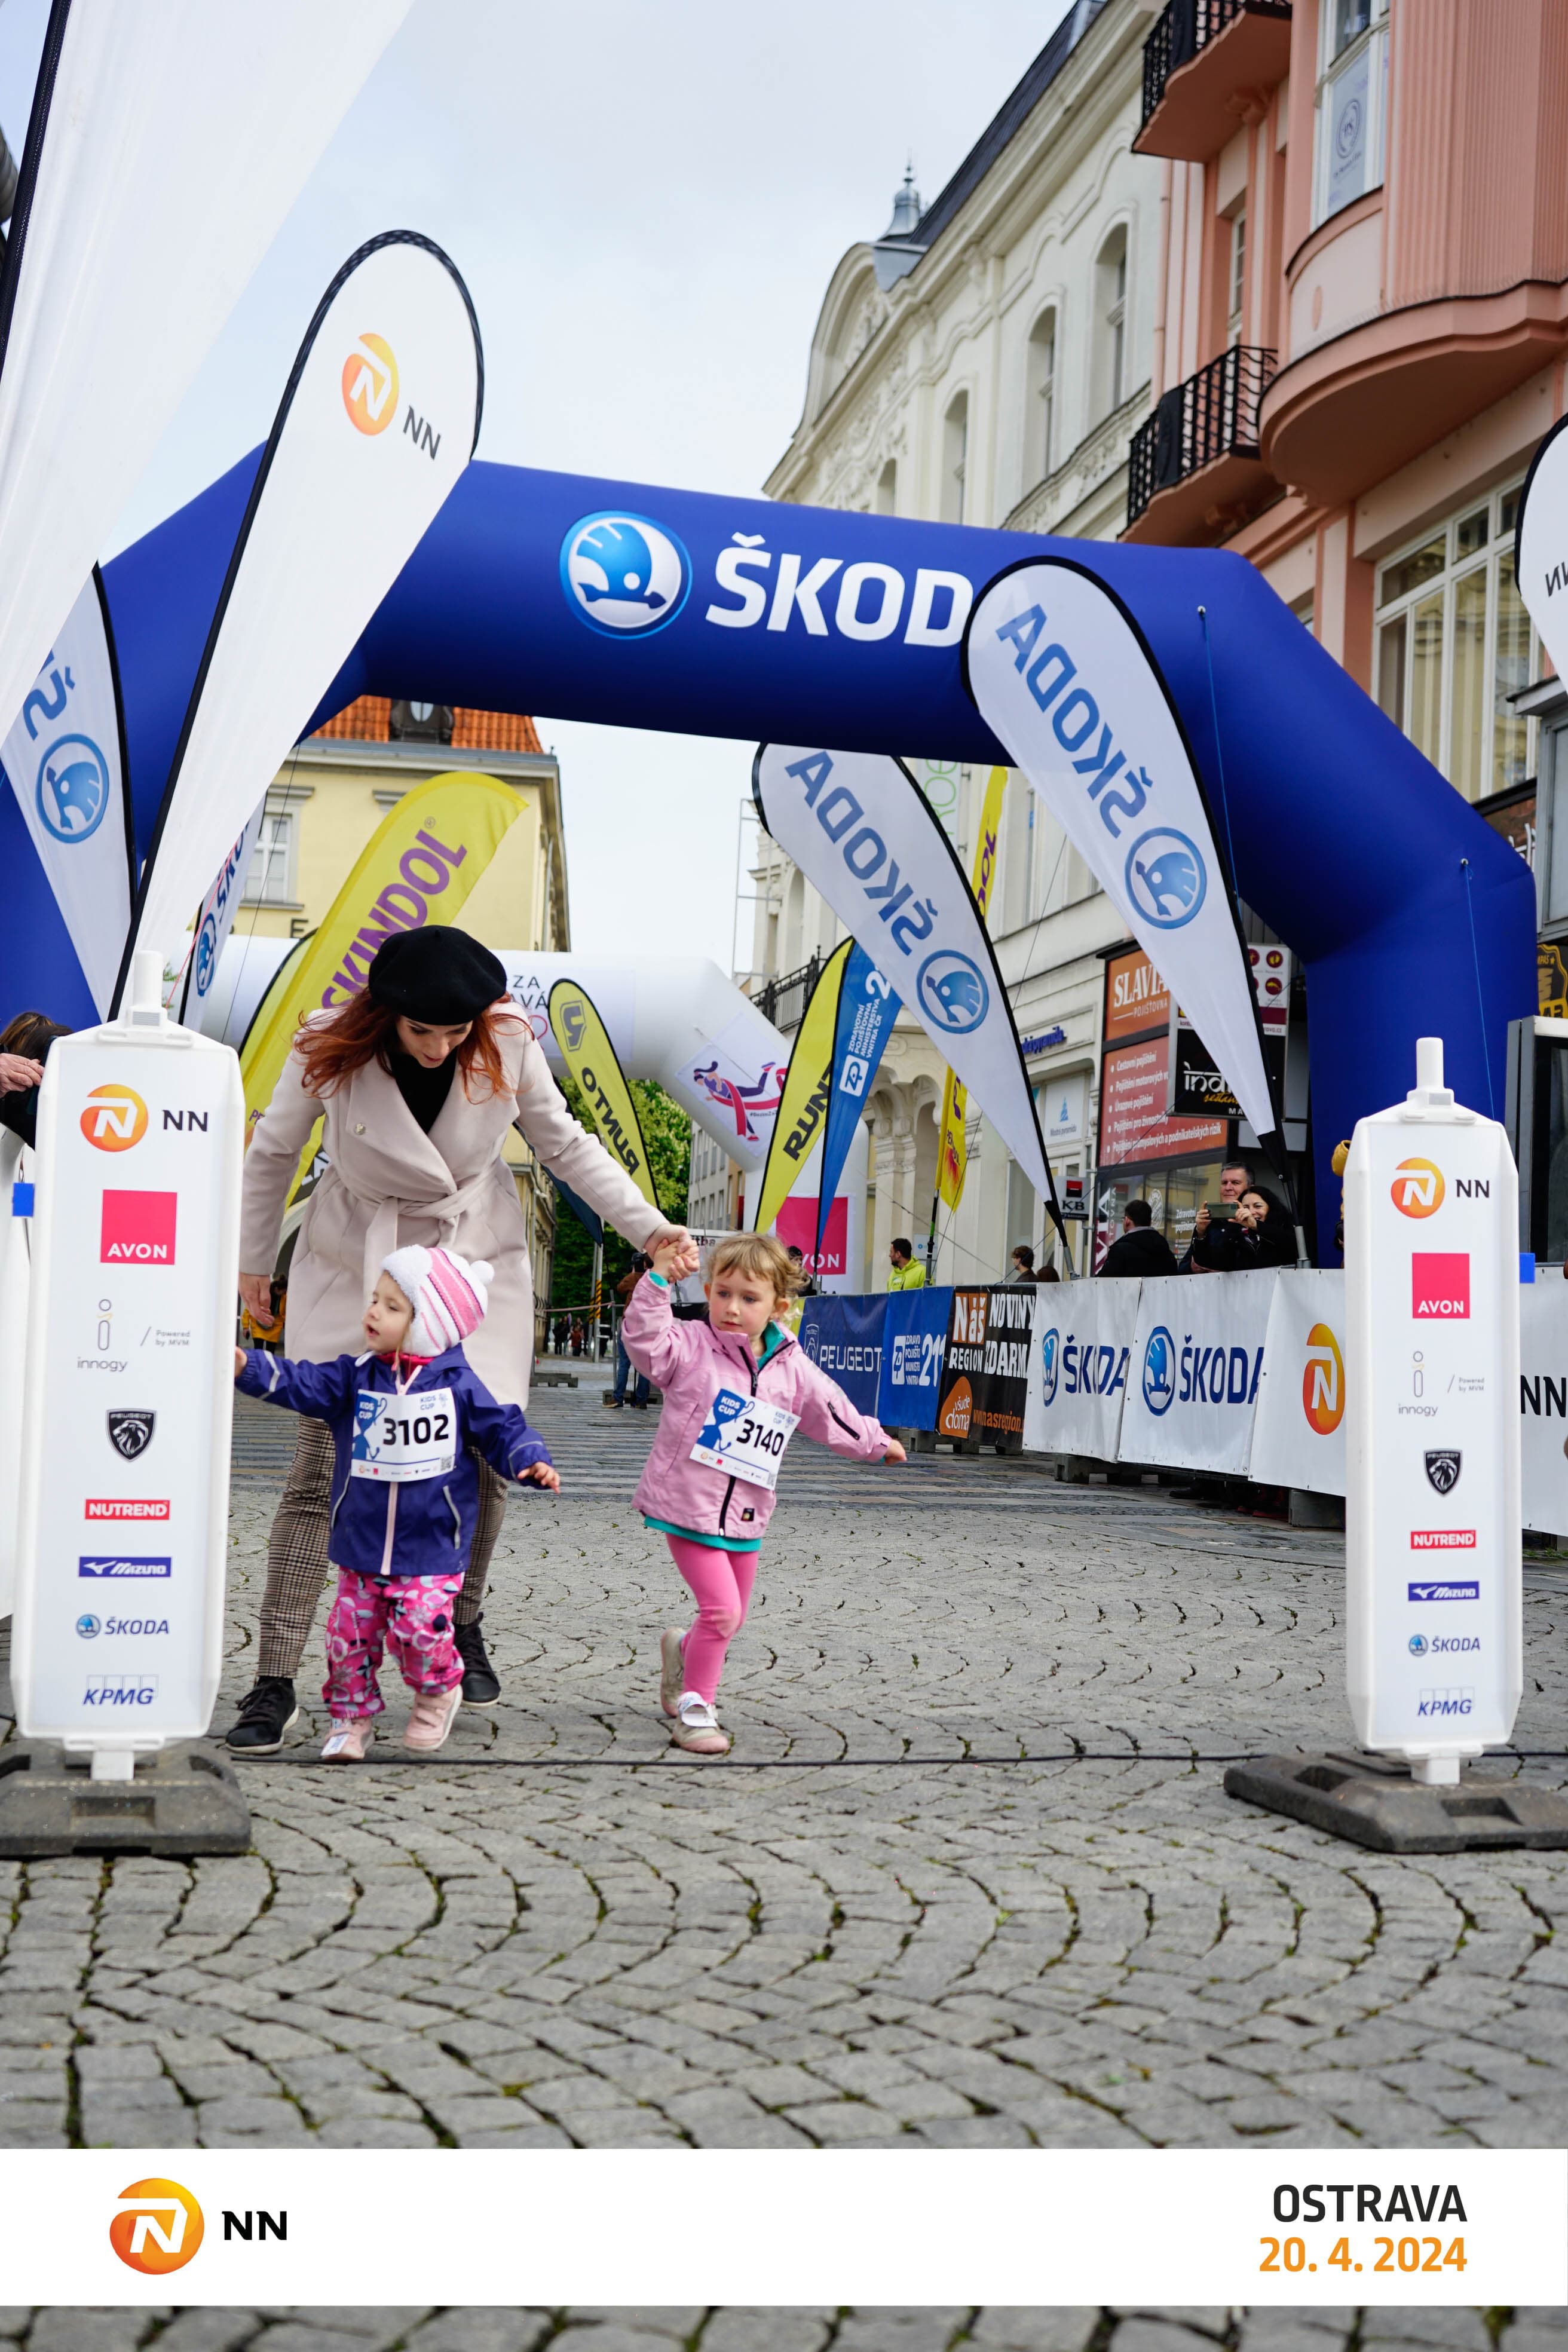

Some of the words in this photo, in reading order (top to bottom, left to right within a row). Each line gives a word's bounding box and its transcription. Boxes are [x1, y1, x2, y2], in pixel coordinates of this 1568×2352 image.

[403, 405, 441, 460] NN
[849, 1004, 865, 1052] ZDRAVOTNÍ
[163, 1109, 208, 1132] NN
[1456, 1179, 1490, 1198] NN
[1062, 1200, 1085, 1210] KB
[107, 1243, 167, 1259] AVON
[989, 1294, 1036, 1330] NOVINY
[1418, 1300, 1464, 1313] AVON
[953, 1296, 985, 1343] Náš
[77, 1356, 128, 1372] innogy
[820, 1346, 882, 1373] PEUGEOT
[949, 1347, 984, 1373] REGION
[721, 1396, 741, 1409] KIDS
[1521, 1375, 1567, 1417] NN
[718, 1405, 736, 1416] CUP
[1398, 1403, 1438, 1417] innogy
[945, 1408, 970, 1431] doma
[383, 1414, 449, 1446] 3102
[736, 1419, 784, 1456] 3140
[88, 1503, 167, 1517] NUTREND
[1414, 1533, 1474, 1546] NUTREND
[105, 1617, 169, 1635] ŠKODA
[1431, 1636, 1481, 1653] ŠKODA
[83, 1688, 155, 1705] KPMG
[1417, 1698, 1472, 1716] KPMG
